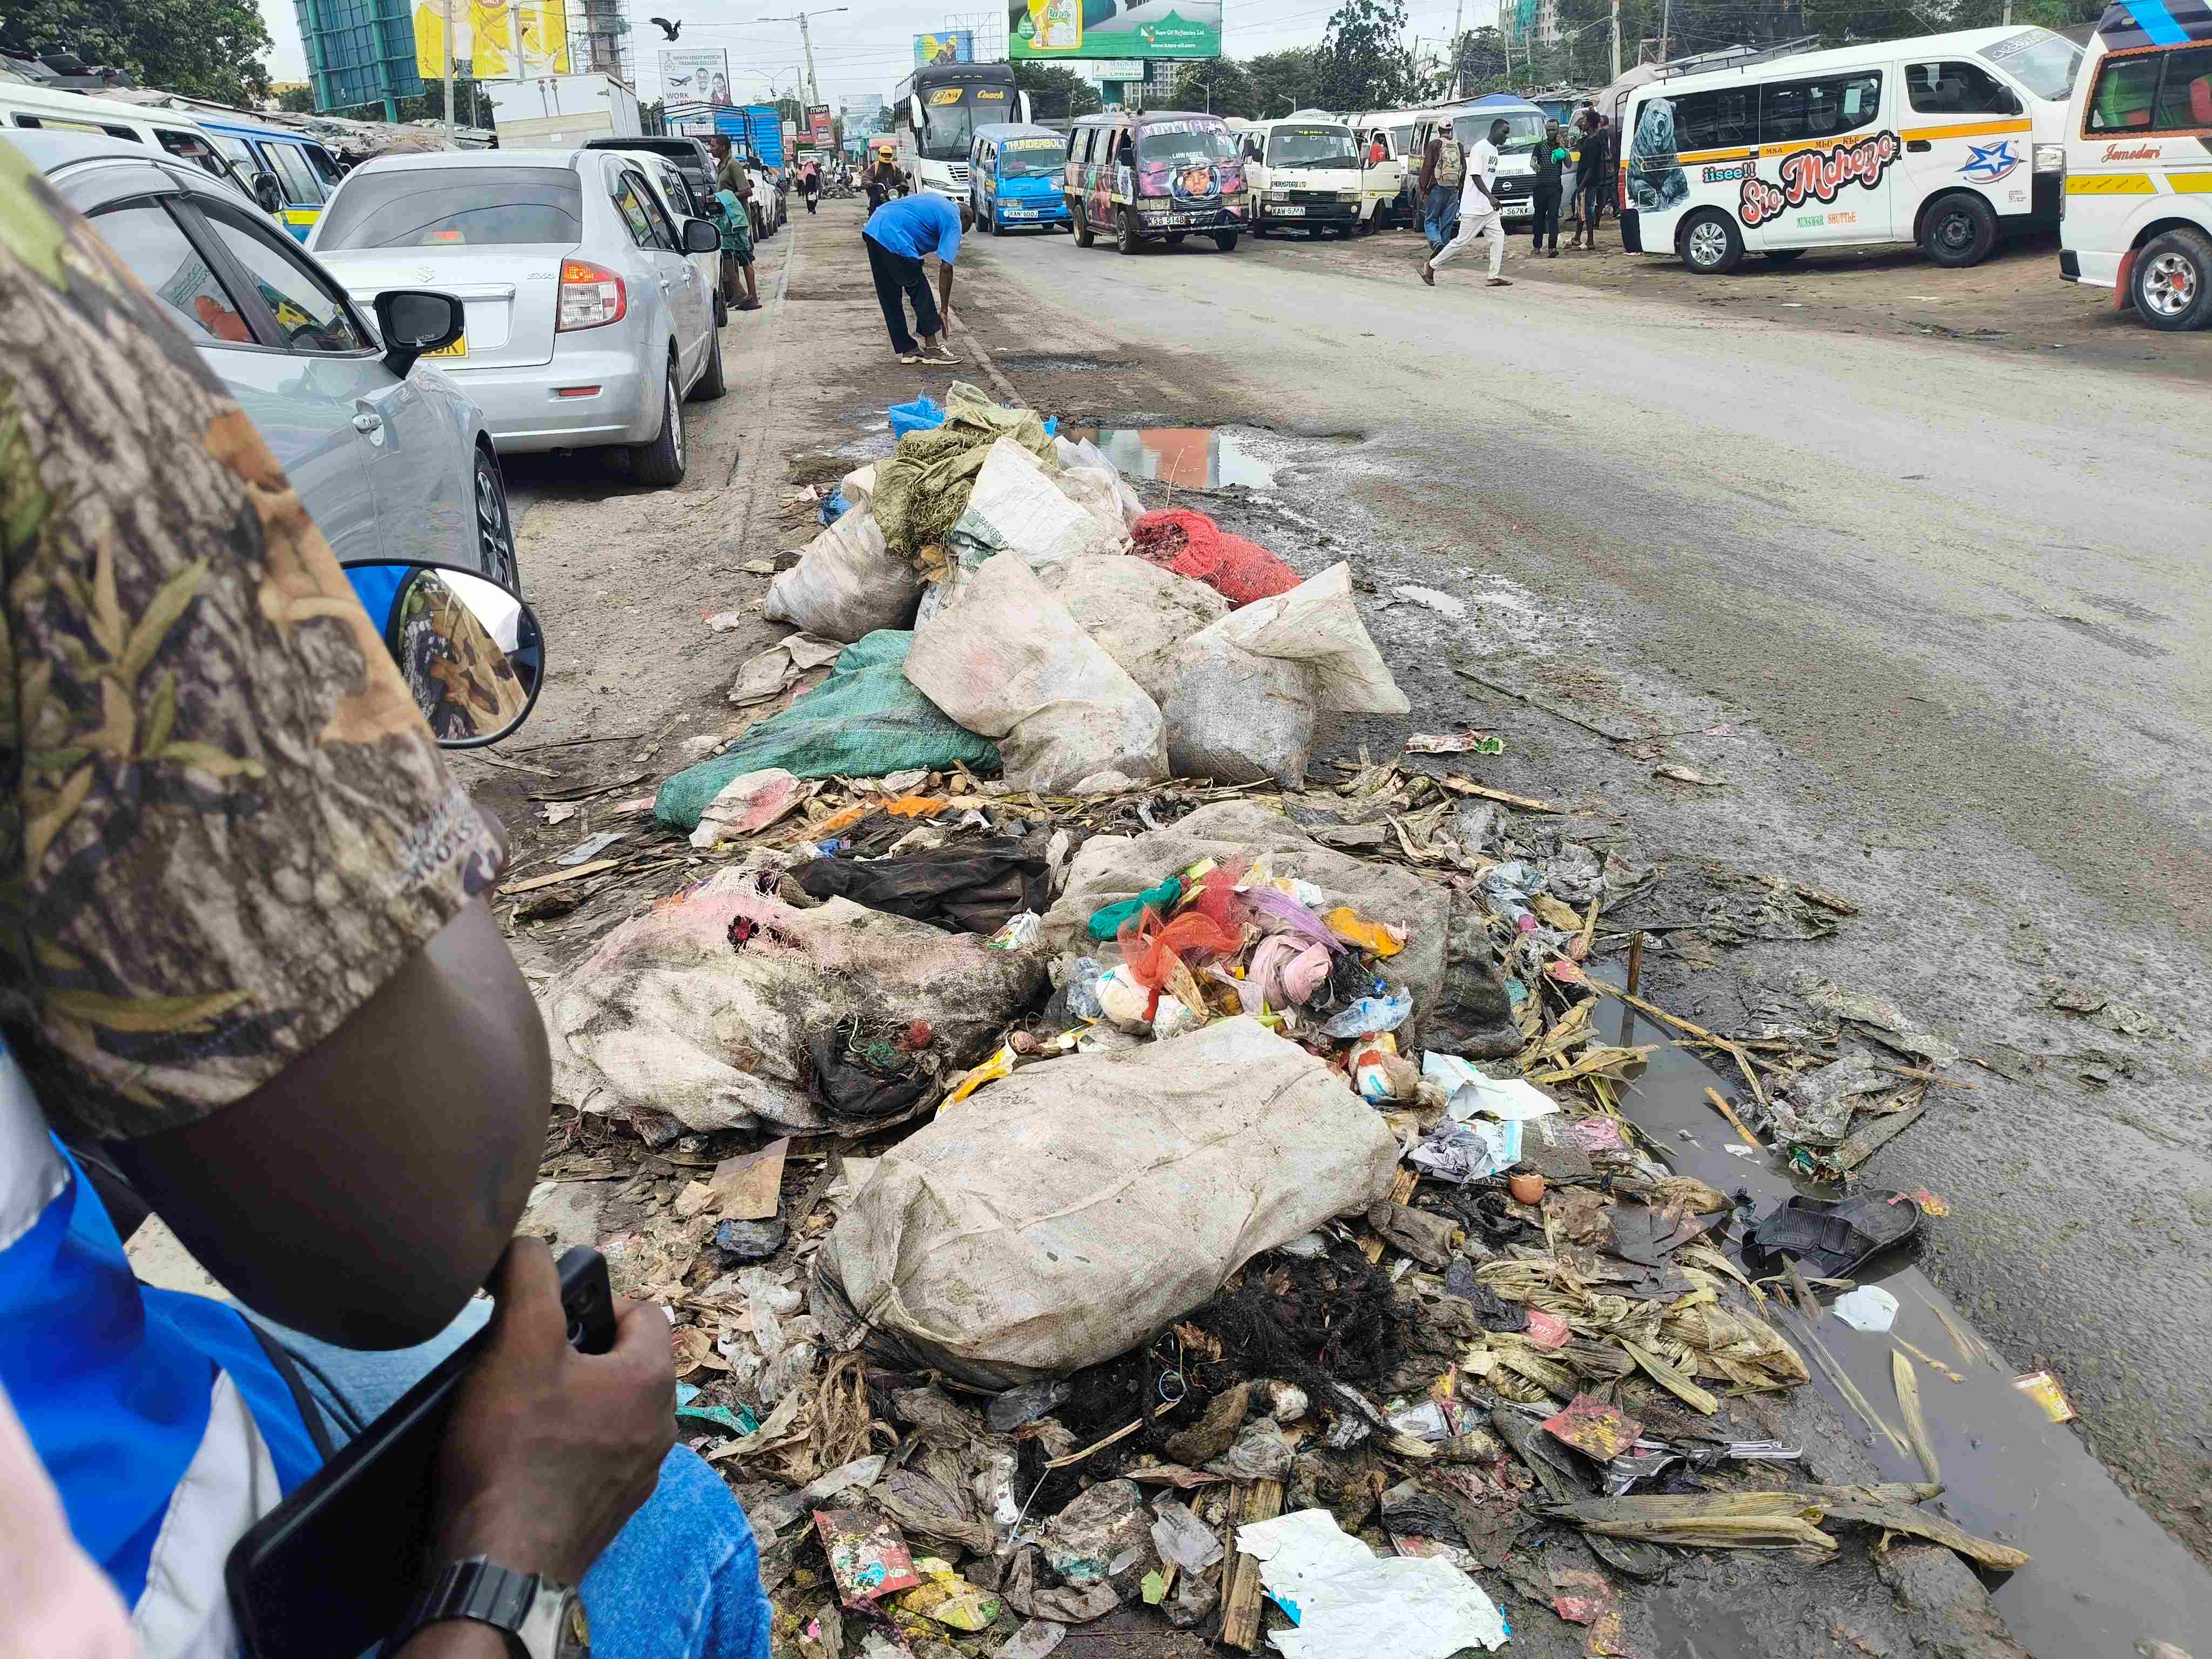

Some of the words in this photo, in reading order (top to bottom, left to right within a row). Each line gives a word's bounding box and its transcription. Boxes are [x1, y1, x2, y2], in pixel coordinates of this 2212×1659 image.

[1048, 8, 1068, 19] Rina
[976, 90, 1004, 99] Coach
[1004, 138, 1067, 150] THUNDERBOLT
[1741, 180, 1784, 224] Sio
[1827, 212, 1858, 225] SHUTTLE
[979, 516, 1003, 542] BAKERS
